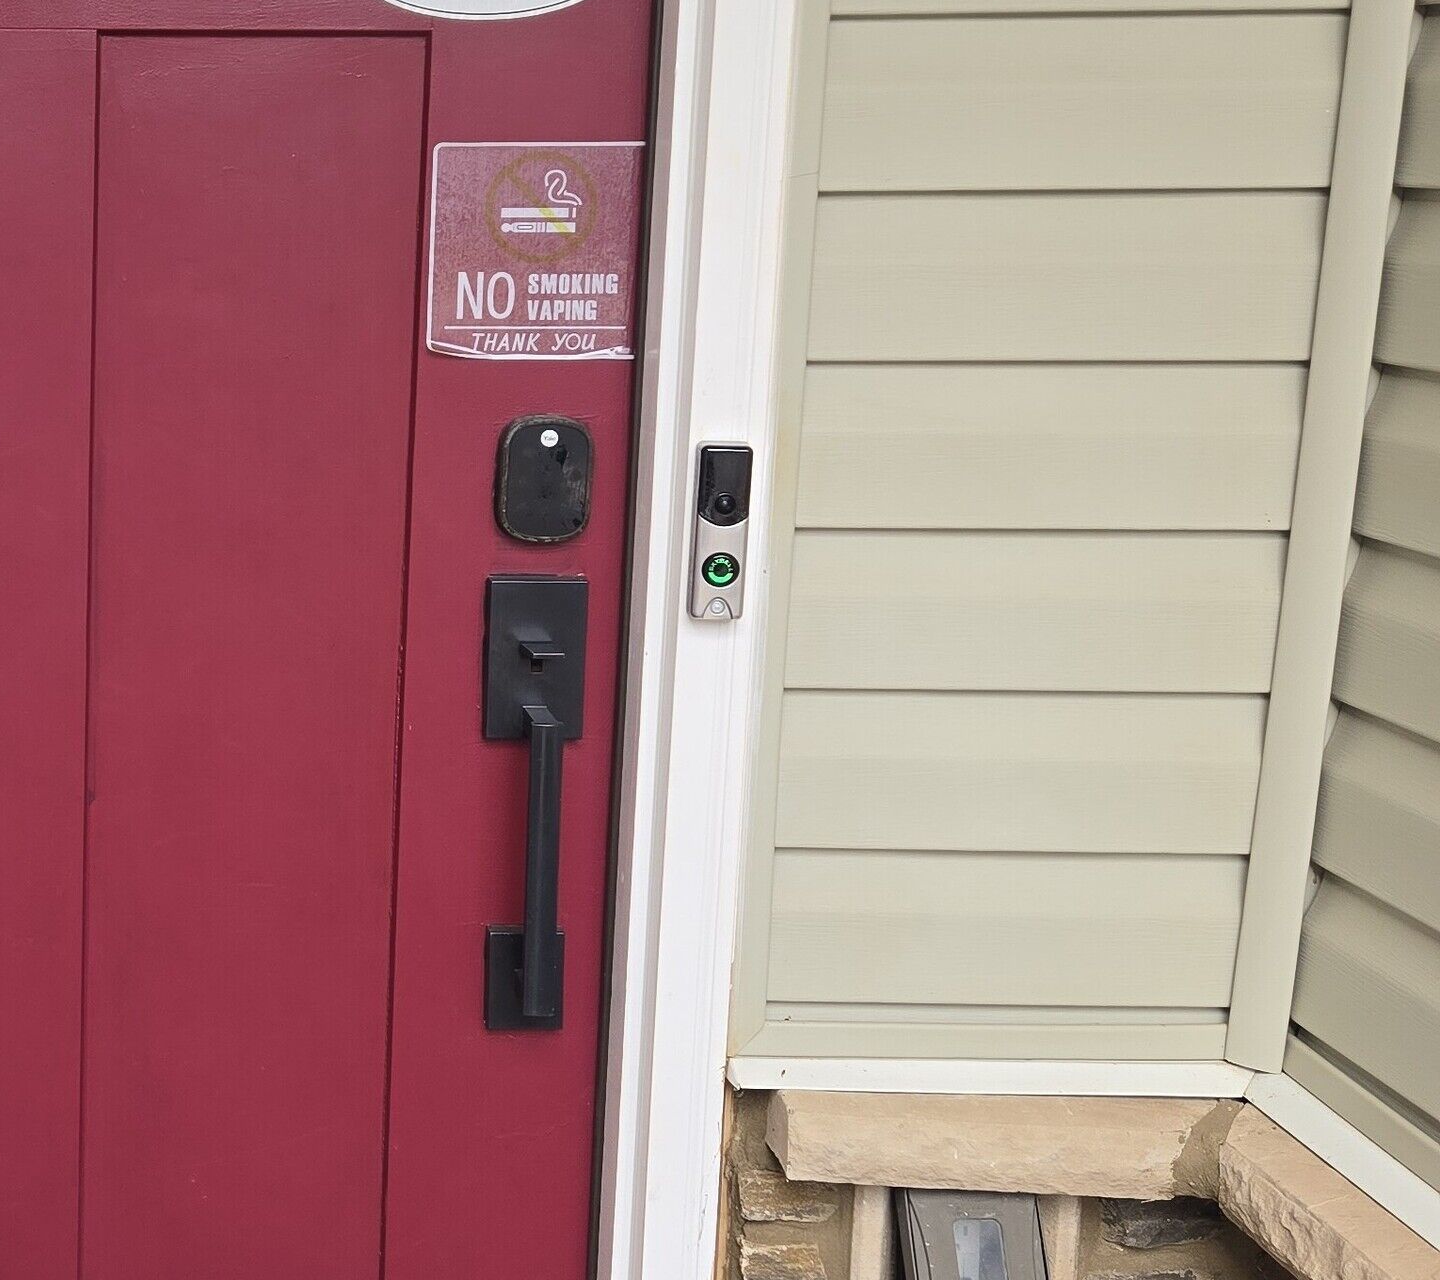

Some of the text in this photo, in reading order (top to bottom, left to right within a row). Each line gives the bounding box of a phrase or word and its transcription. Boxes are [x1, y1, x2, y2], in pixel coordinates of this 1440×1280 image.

[456, 271, 619, 320] NO SMOKING
[527, 299, 598, 321] VAPING
[471, 332, 597, 352] THANK YOU
